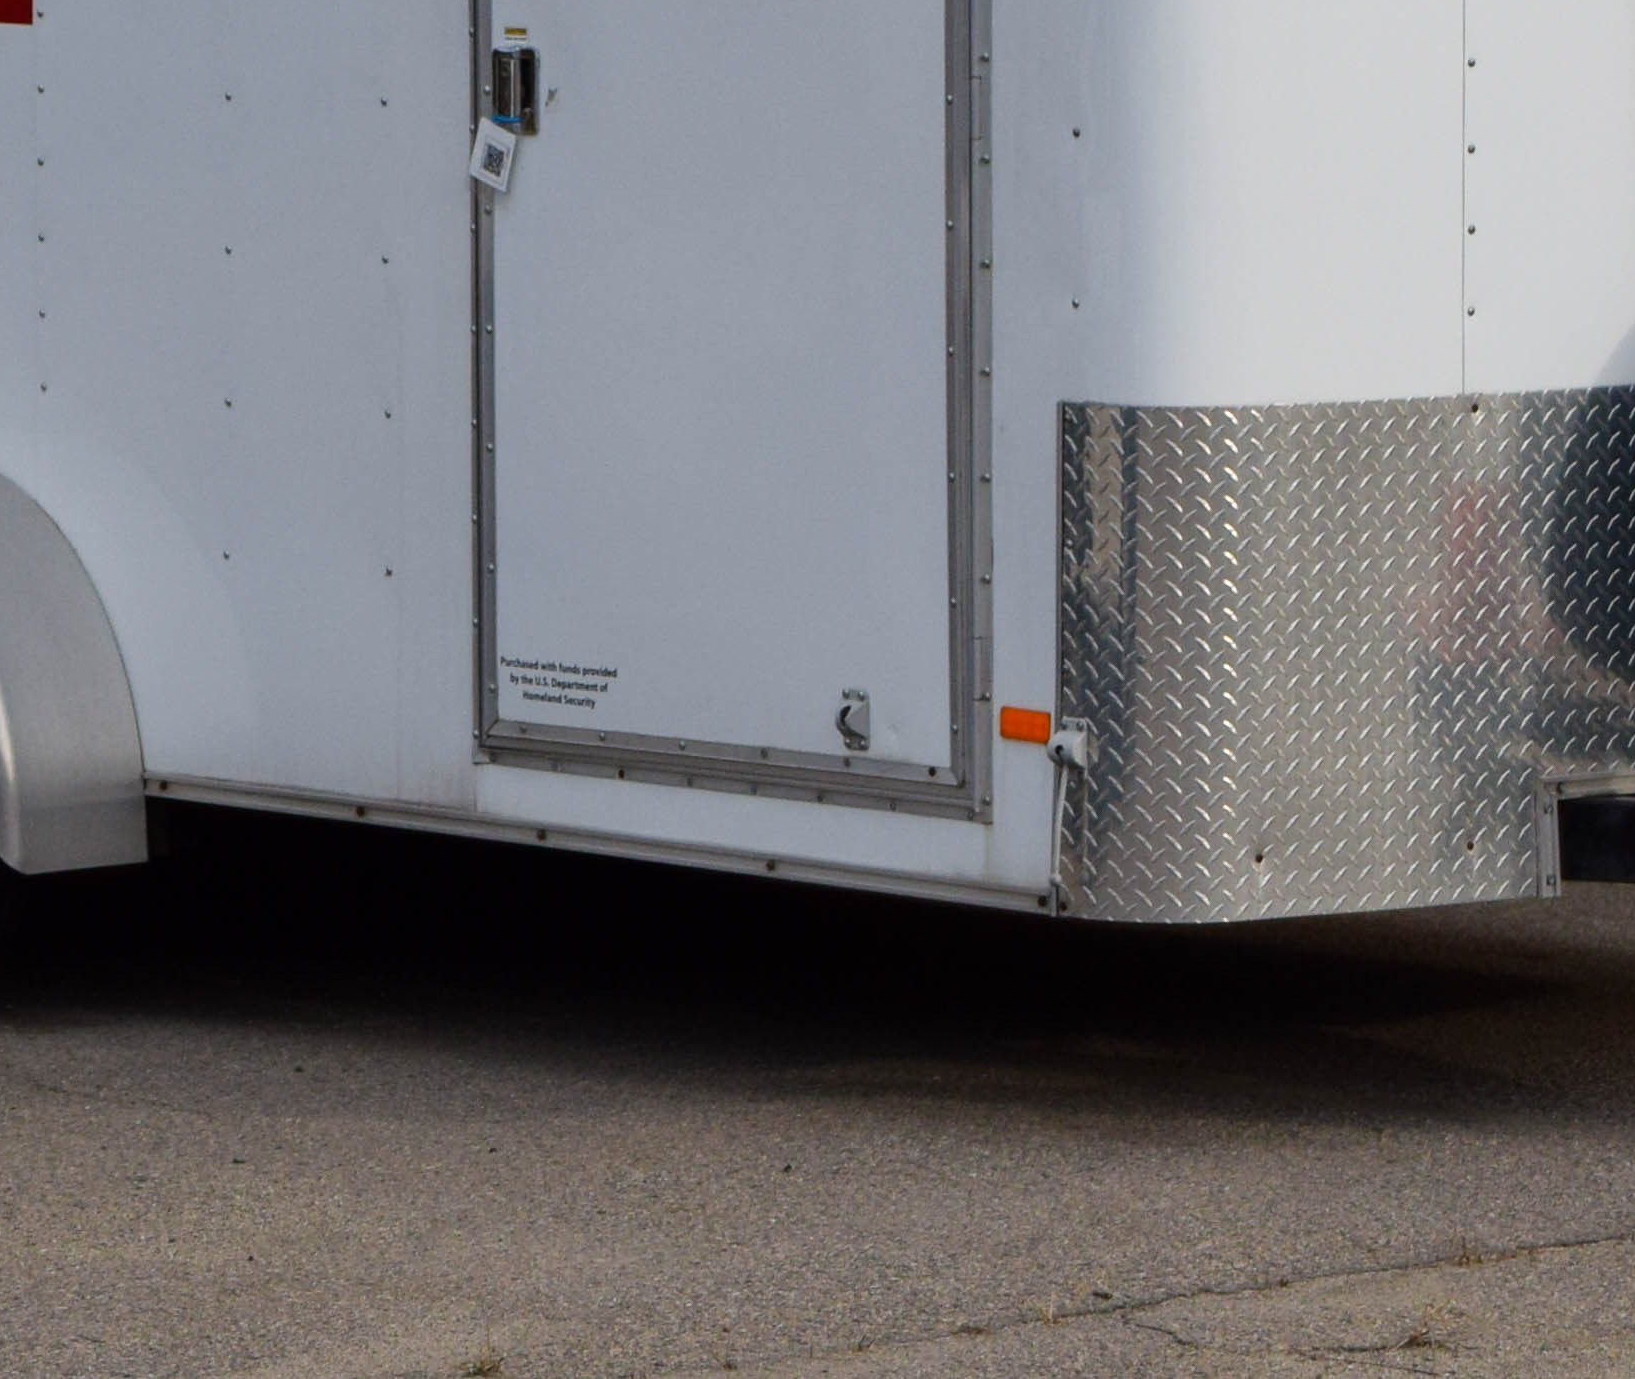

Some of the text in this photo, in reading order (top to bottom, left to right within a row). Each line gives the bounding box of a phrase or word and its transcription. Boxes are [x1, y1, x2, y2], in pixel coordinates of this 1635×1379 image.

[500, 656, 617, 678] Purchased with funds provided
[510, 672, 608, 692] by the U.S. Department of
[522, 691, 596, 709] Homeland Security
